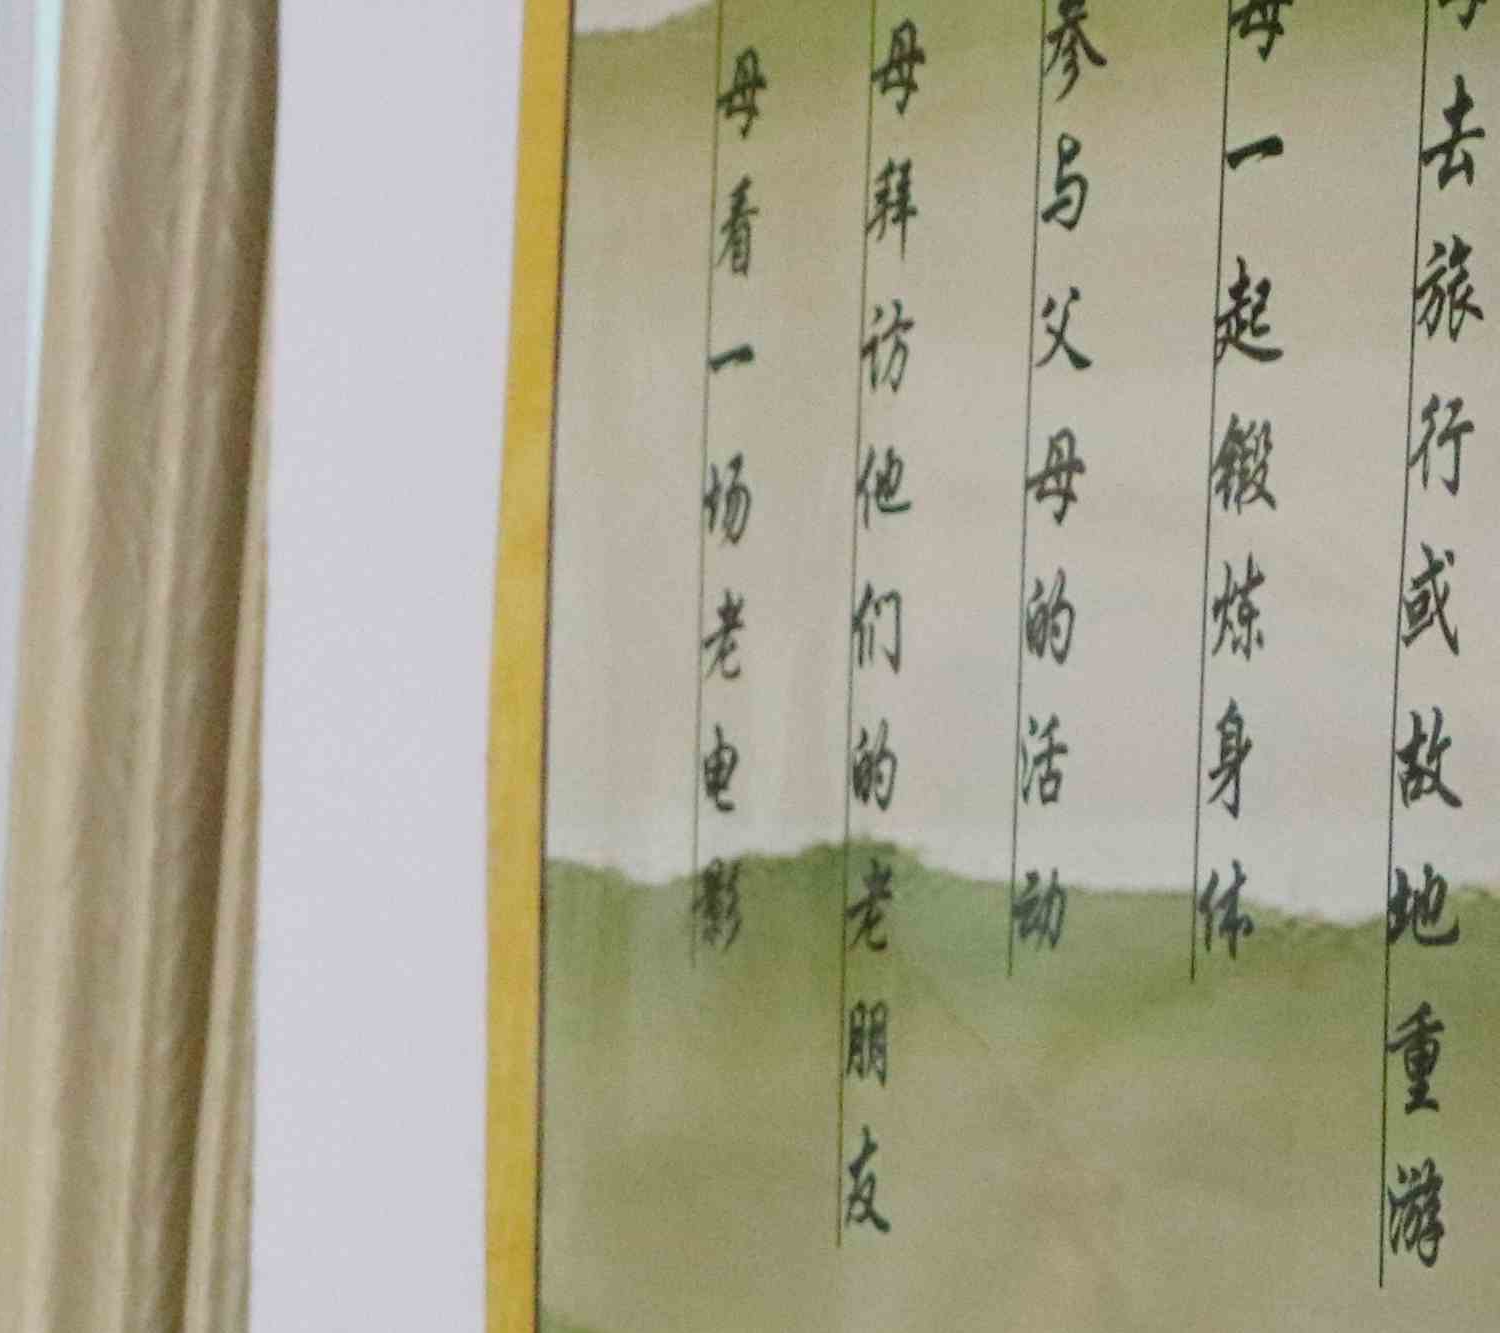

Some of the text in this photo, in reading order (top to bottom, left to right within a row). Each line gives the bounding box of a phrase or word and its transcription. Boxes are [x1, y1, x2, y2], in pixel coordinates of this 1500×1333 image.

[695, 46, 767, 953] 母看一场老电影
[844, 20, 925, 1234] 母拜访他们的老朋友
[1013, 0, 1106, 951] 参与父母的活动
